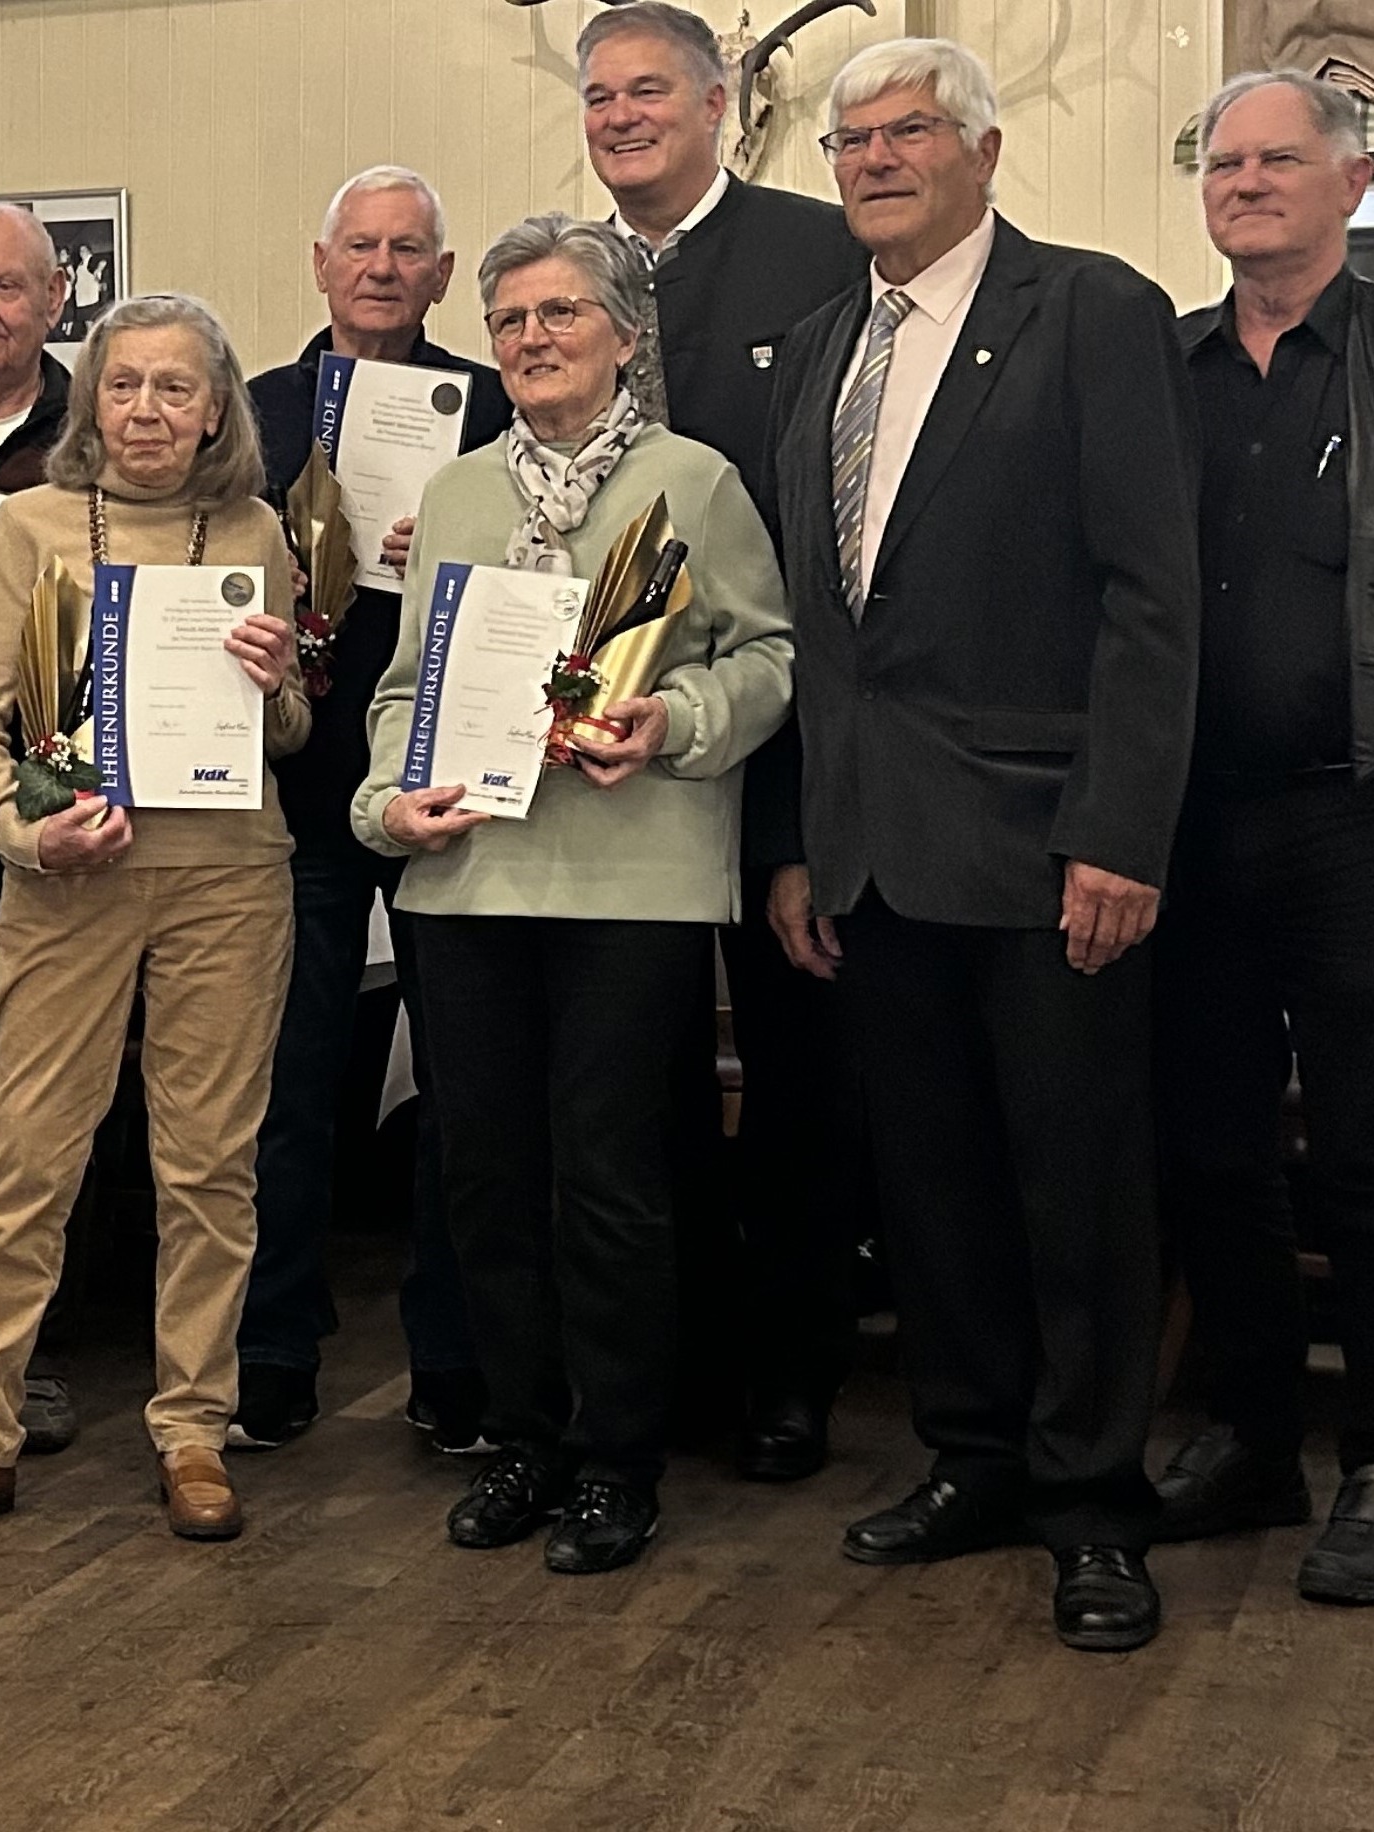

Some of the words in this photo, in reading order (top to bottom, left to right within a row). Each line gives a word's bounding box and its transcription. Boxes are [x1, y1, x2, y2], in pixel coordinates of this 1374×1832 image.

[101, 612, 119, 788] EHRENURKUNDE
[193, 769, 230, 781] VdK
[407, 609, 450, 783] EHRENURKUNDE
